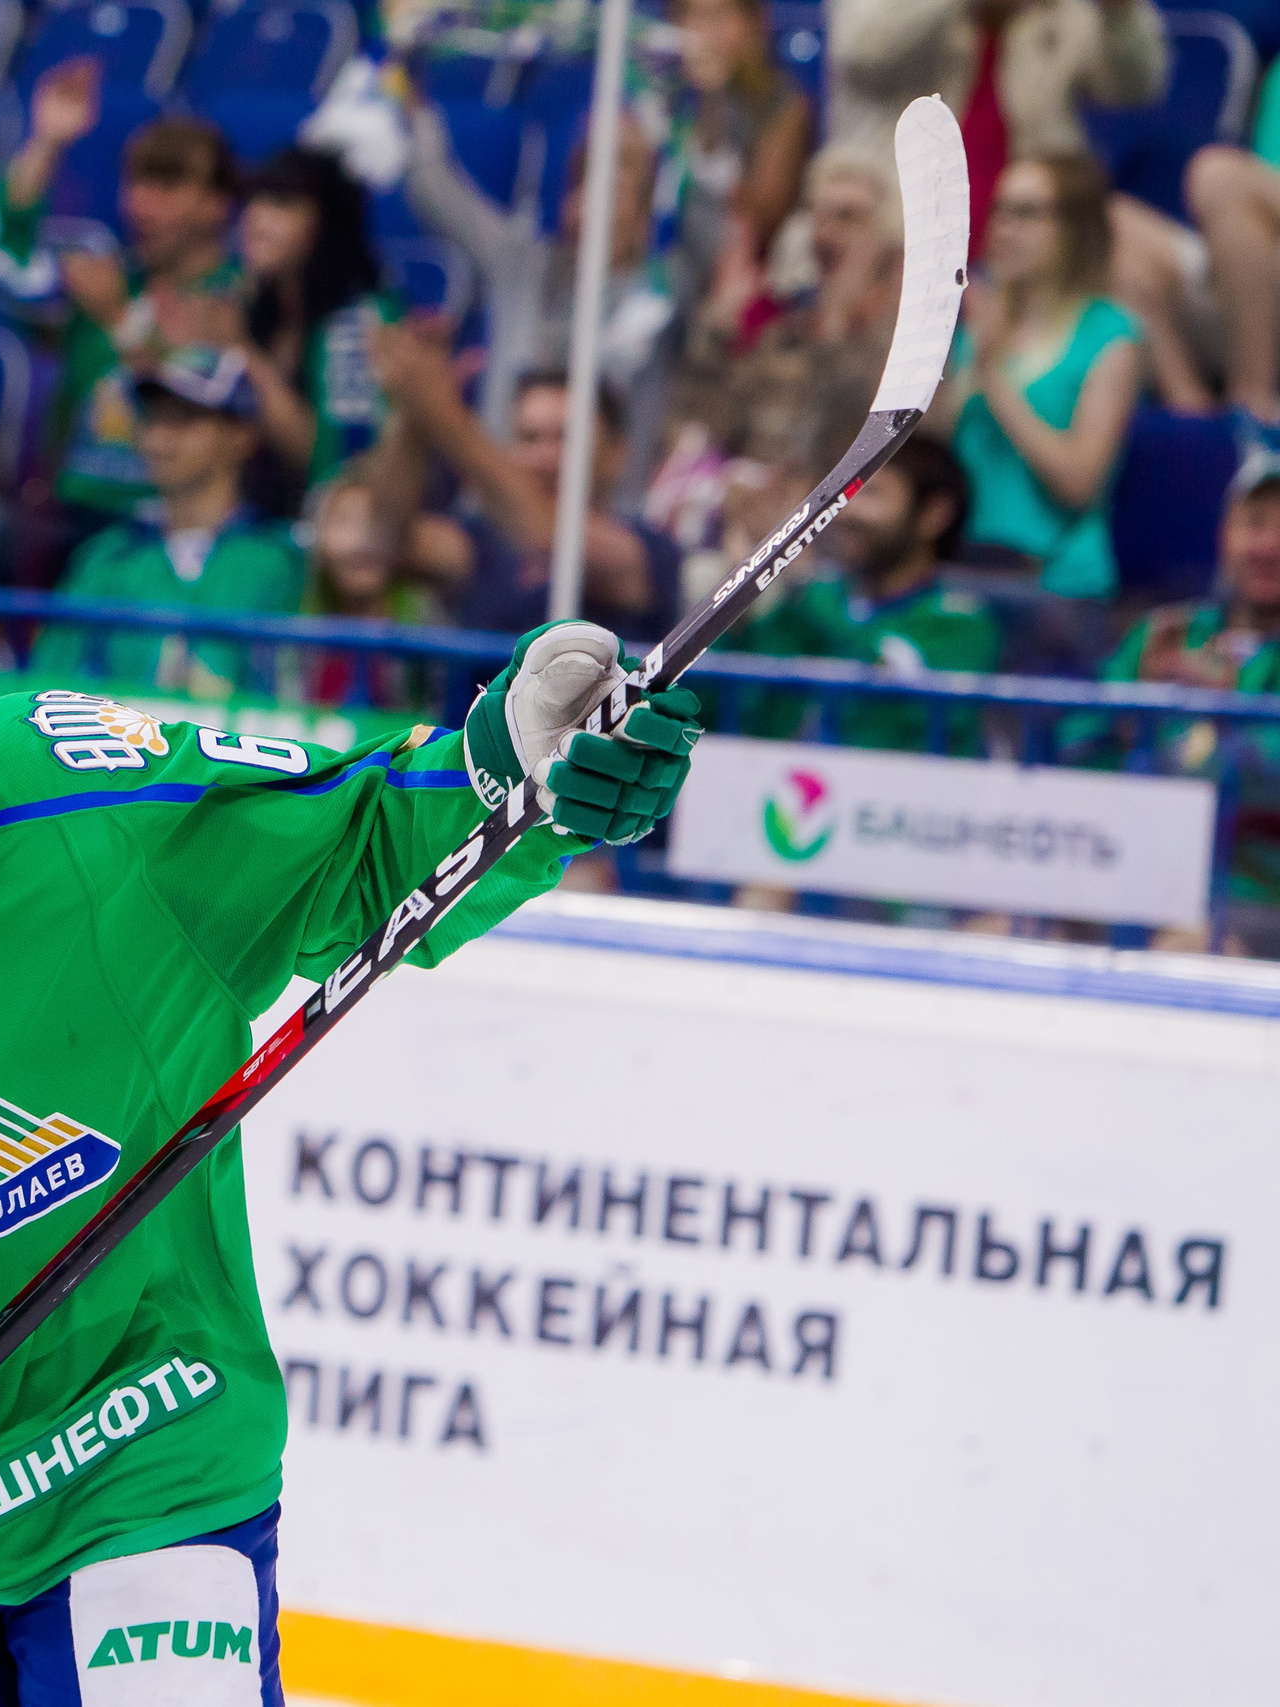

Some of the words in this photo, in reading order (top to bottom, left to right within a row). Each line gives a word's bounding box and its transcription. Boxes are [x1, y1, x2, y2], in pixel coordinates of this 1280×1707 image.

[712, 502, 811, 610] SYNERGY
[755, 492, 848, 592] EASTON
[197, 724, 310, 776] 6
[853, 801, 1122, 870] БАШНЕФТЬ
[291, 1132, 1227, 1311] КОНТИНЕНТАЛЬНАЯ
[282, 1245, 840, 1381] ХОККЕЙНАЯ
[86, 1620, 254, 1670] ATUM
